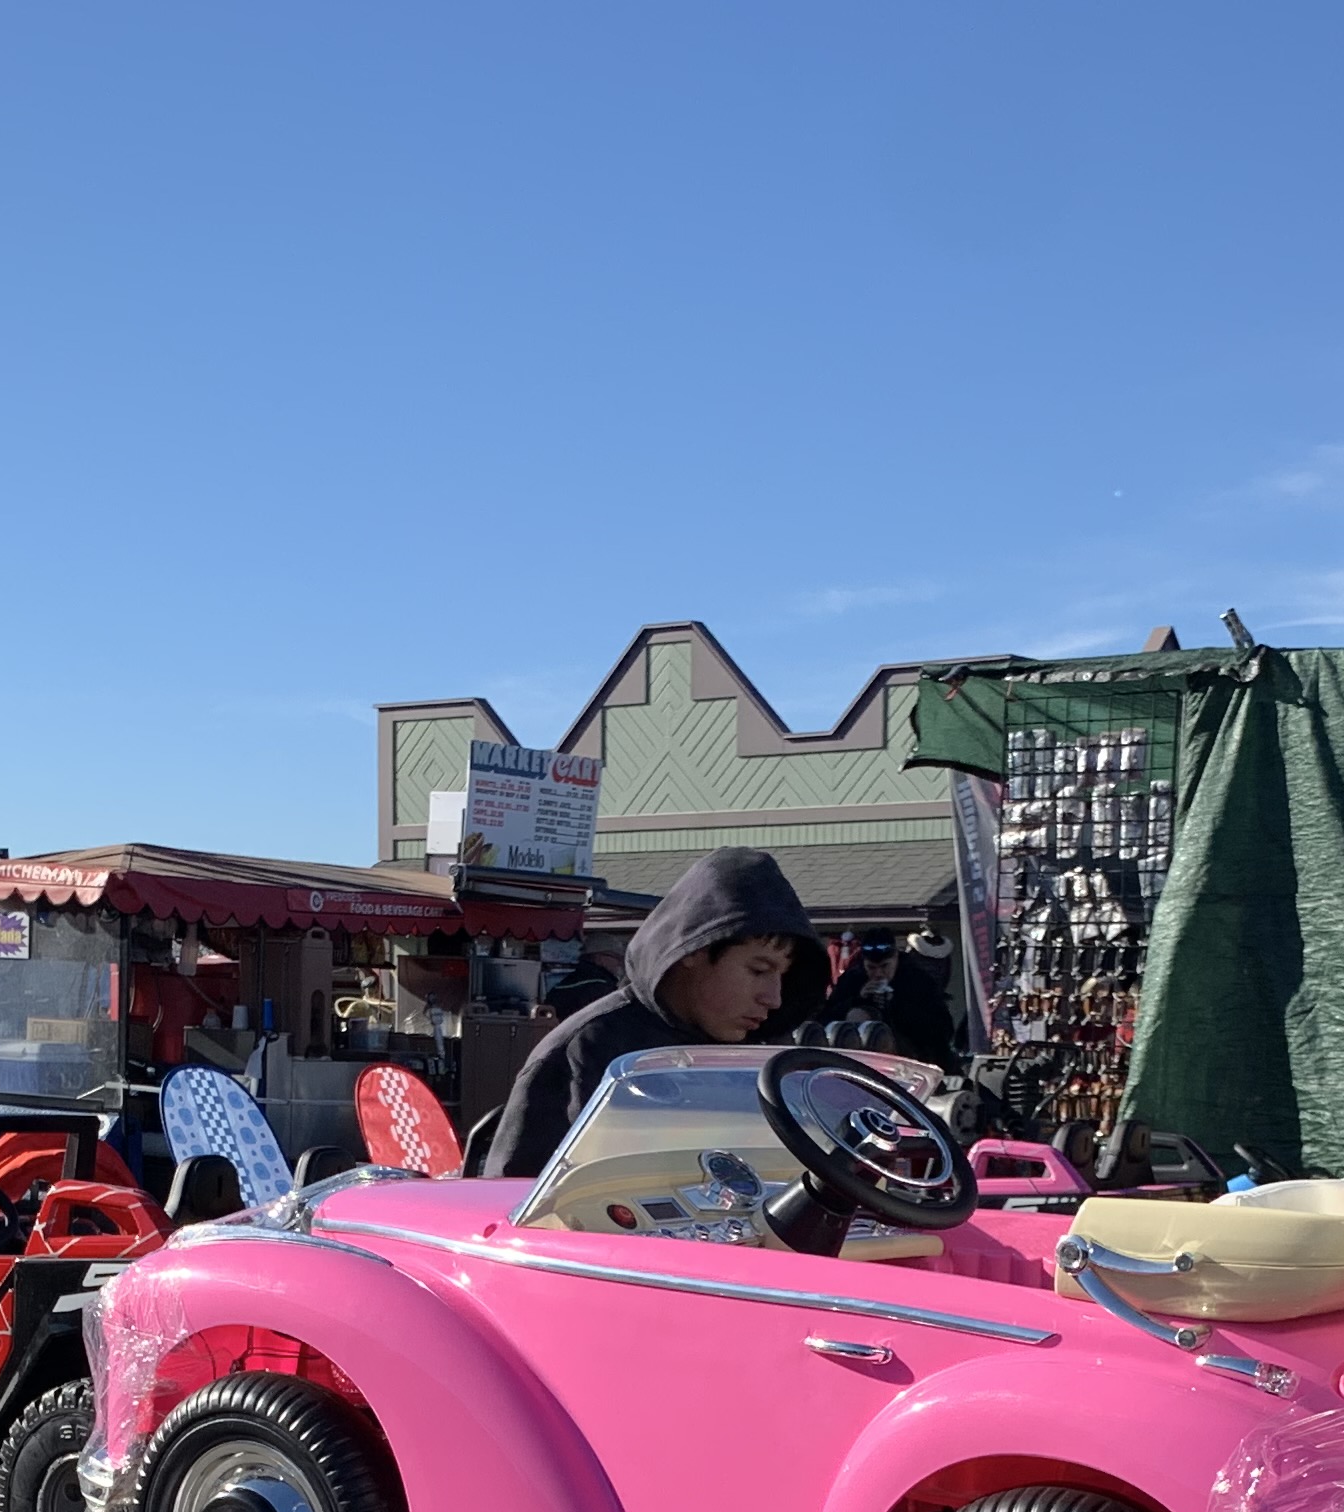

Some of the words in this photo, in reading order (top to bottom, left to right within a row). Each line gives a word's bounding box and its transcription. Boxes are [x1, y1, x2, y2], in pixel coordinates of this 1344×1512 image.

[471, 740, 552, 780] MARKET
[552, 755, 602, 788] CART
[508, 845, 545, 869] Modelo
[381, 904, 423, 917] BEVERAGE
